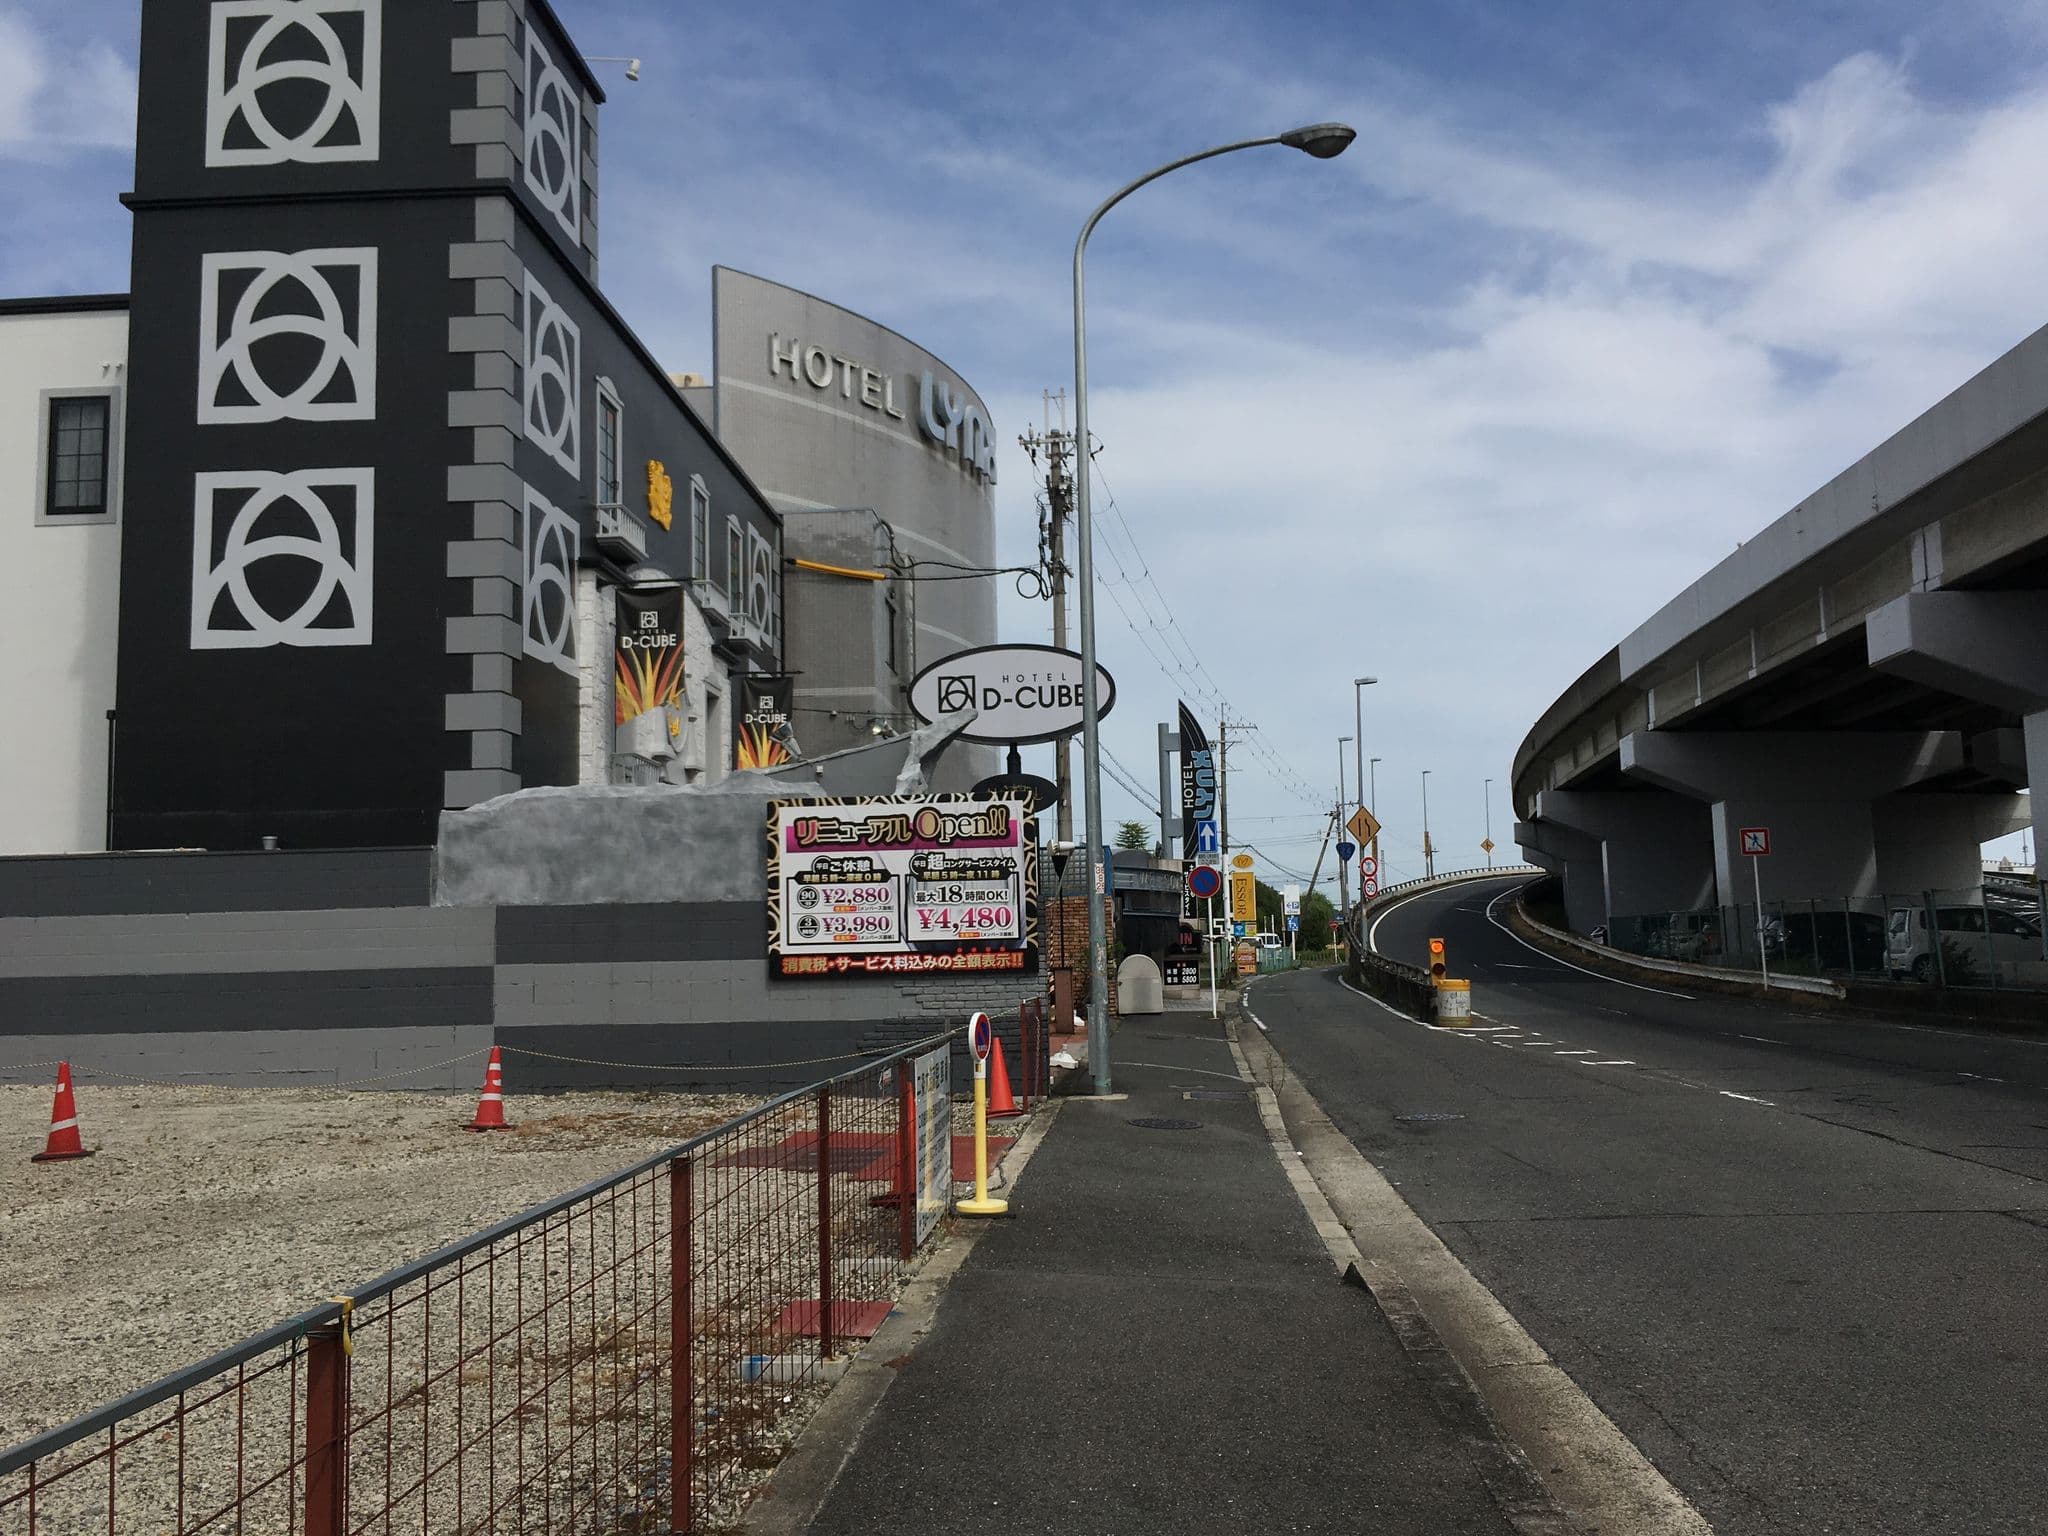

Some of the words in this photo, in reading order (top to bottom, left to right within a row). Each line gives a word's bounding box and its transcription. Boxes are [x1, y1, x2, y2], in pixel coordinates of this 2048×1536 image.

[770, 331, 905, 419] HOTEL
[622, 634, 677, 649] D-CUBE
[1002, 673, 1066, 683] HOTEL
[983, 684, 1084, 710] D-CUBE
[745, 714, 787, 724] D-CUBE
[1183, 762, 1194, 808] HOTEL
[796, 816, 911, 844] リニューアル
[916, 808, 1006, 842] Open!!
[830, 860, 870, 872] ご休憩
[801, 891, 815, 900] 90
[822, 887, 890, 904] ¥2,880
[916, 885, 1008, 902] 最大18時間OK!
[1366, 883, 1375, 892] 50
[1236, 878, 1247, 915] ESSOR
[822, 916, 890, 933] ¥3,980
[916, 907, 1011, 933] ¥4,480
[1180, 932, 1192, 944] IN
